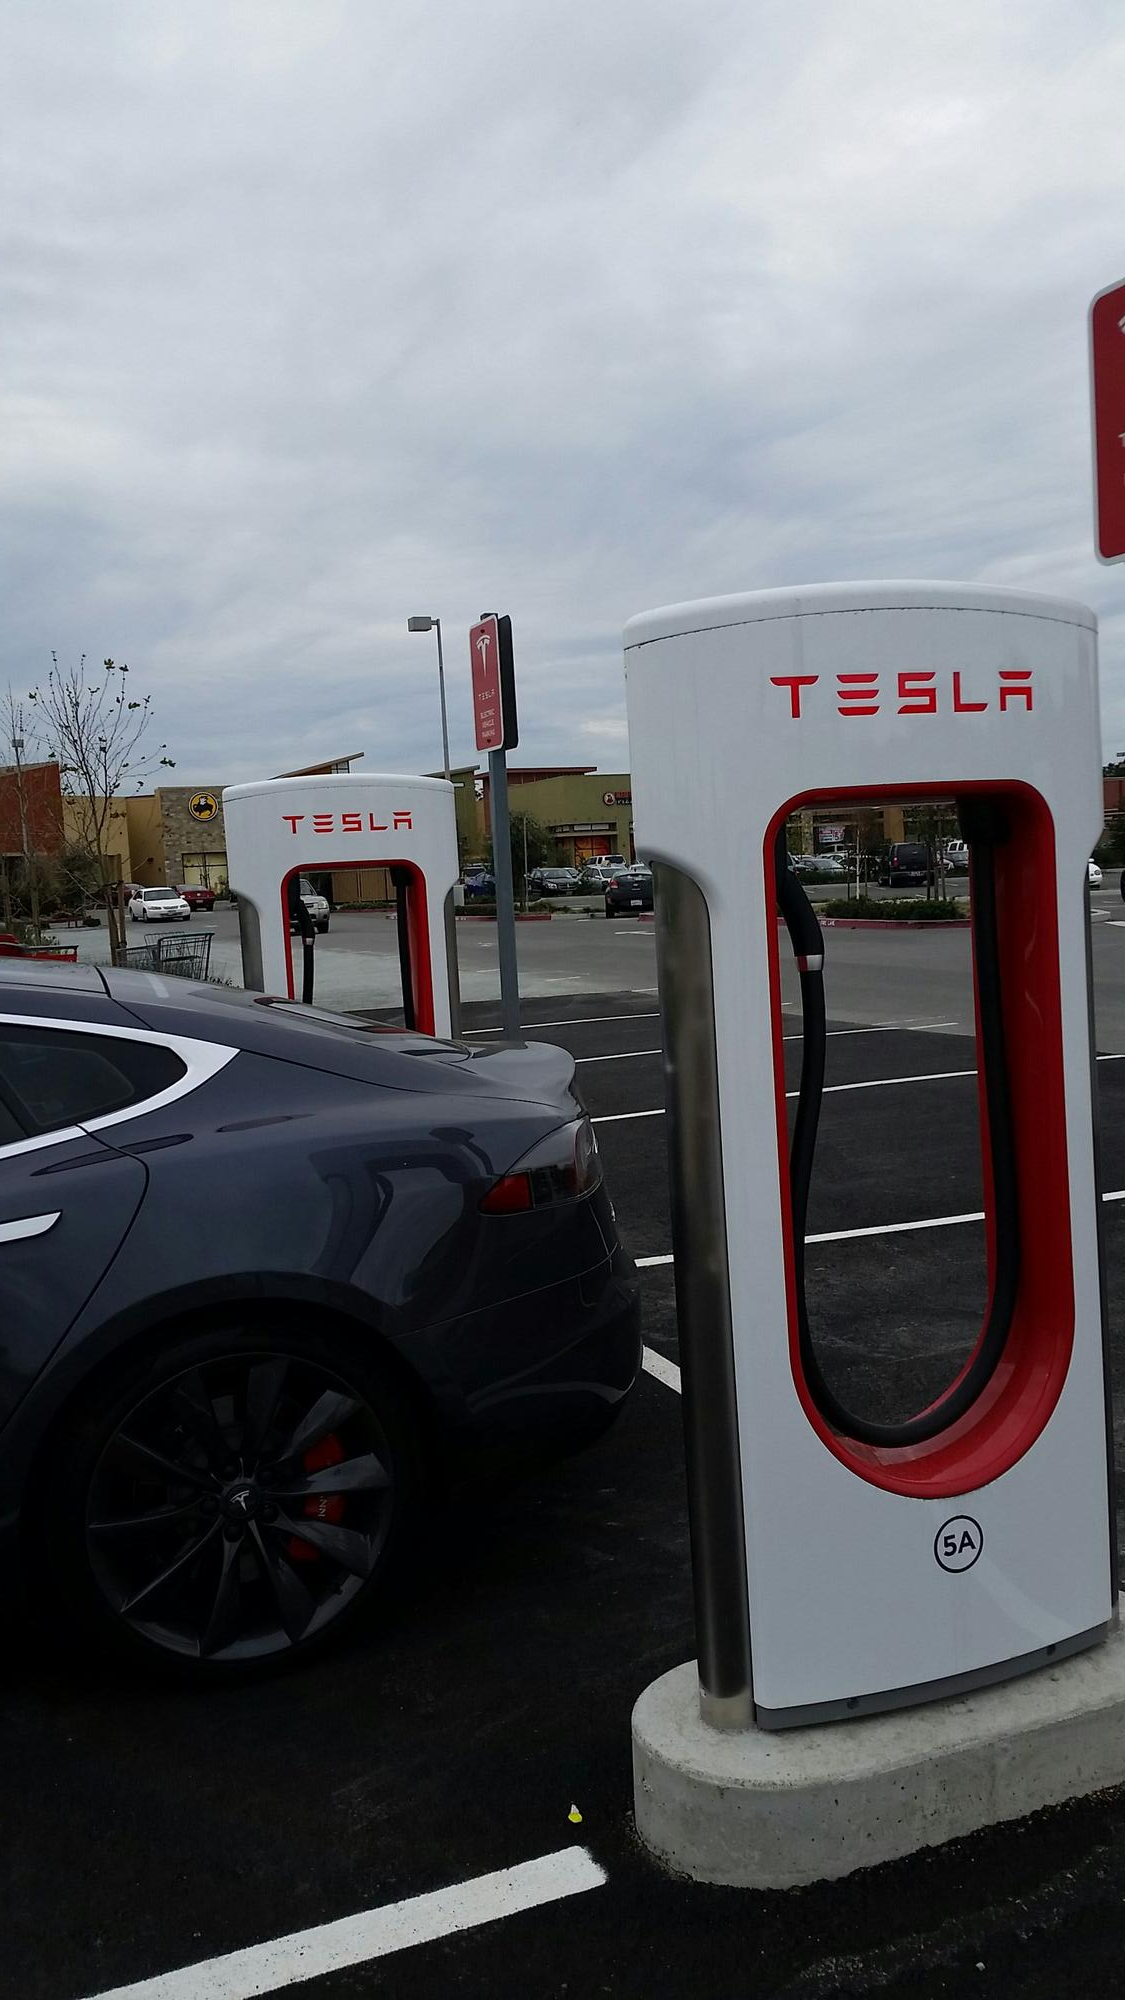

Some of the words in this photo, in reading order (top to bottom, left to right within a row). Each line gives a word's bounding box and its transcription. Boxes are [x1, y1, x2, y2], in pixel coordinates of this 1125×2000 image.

[769, 670, 1033, 719] TESLA
[281, 811, 413, 835] TESLA
[943, 1530, 977, 1557] 5A
